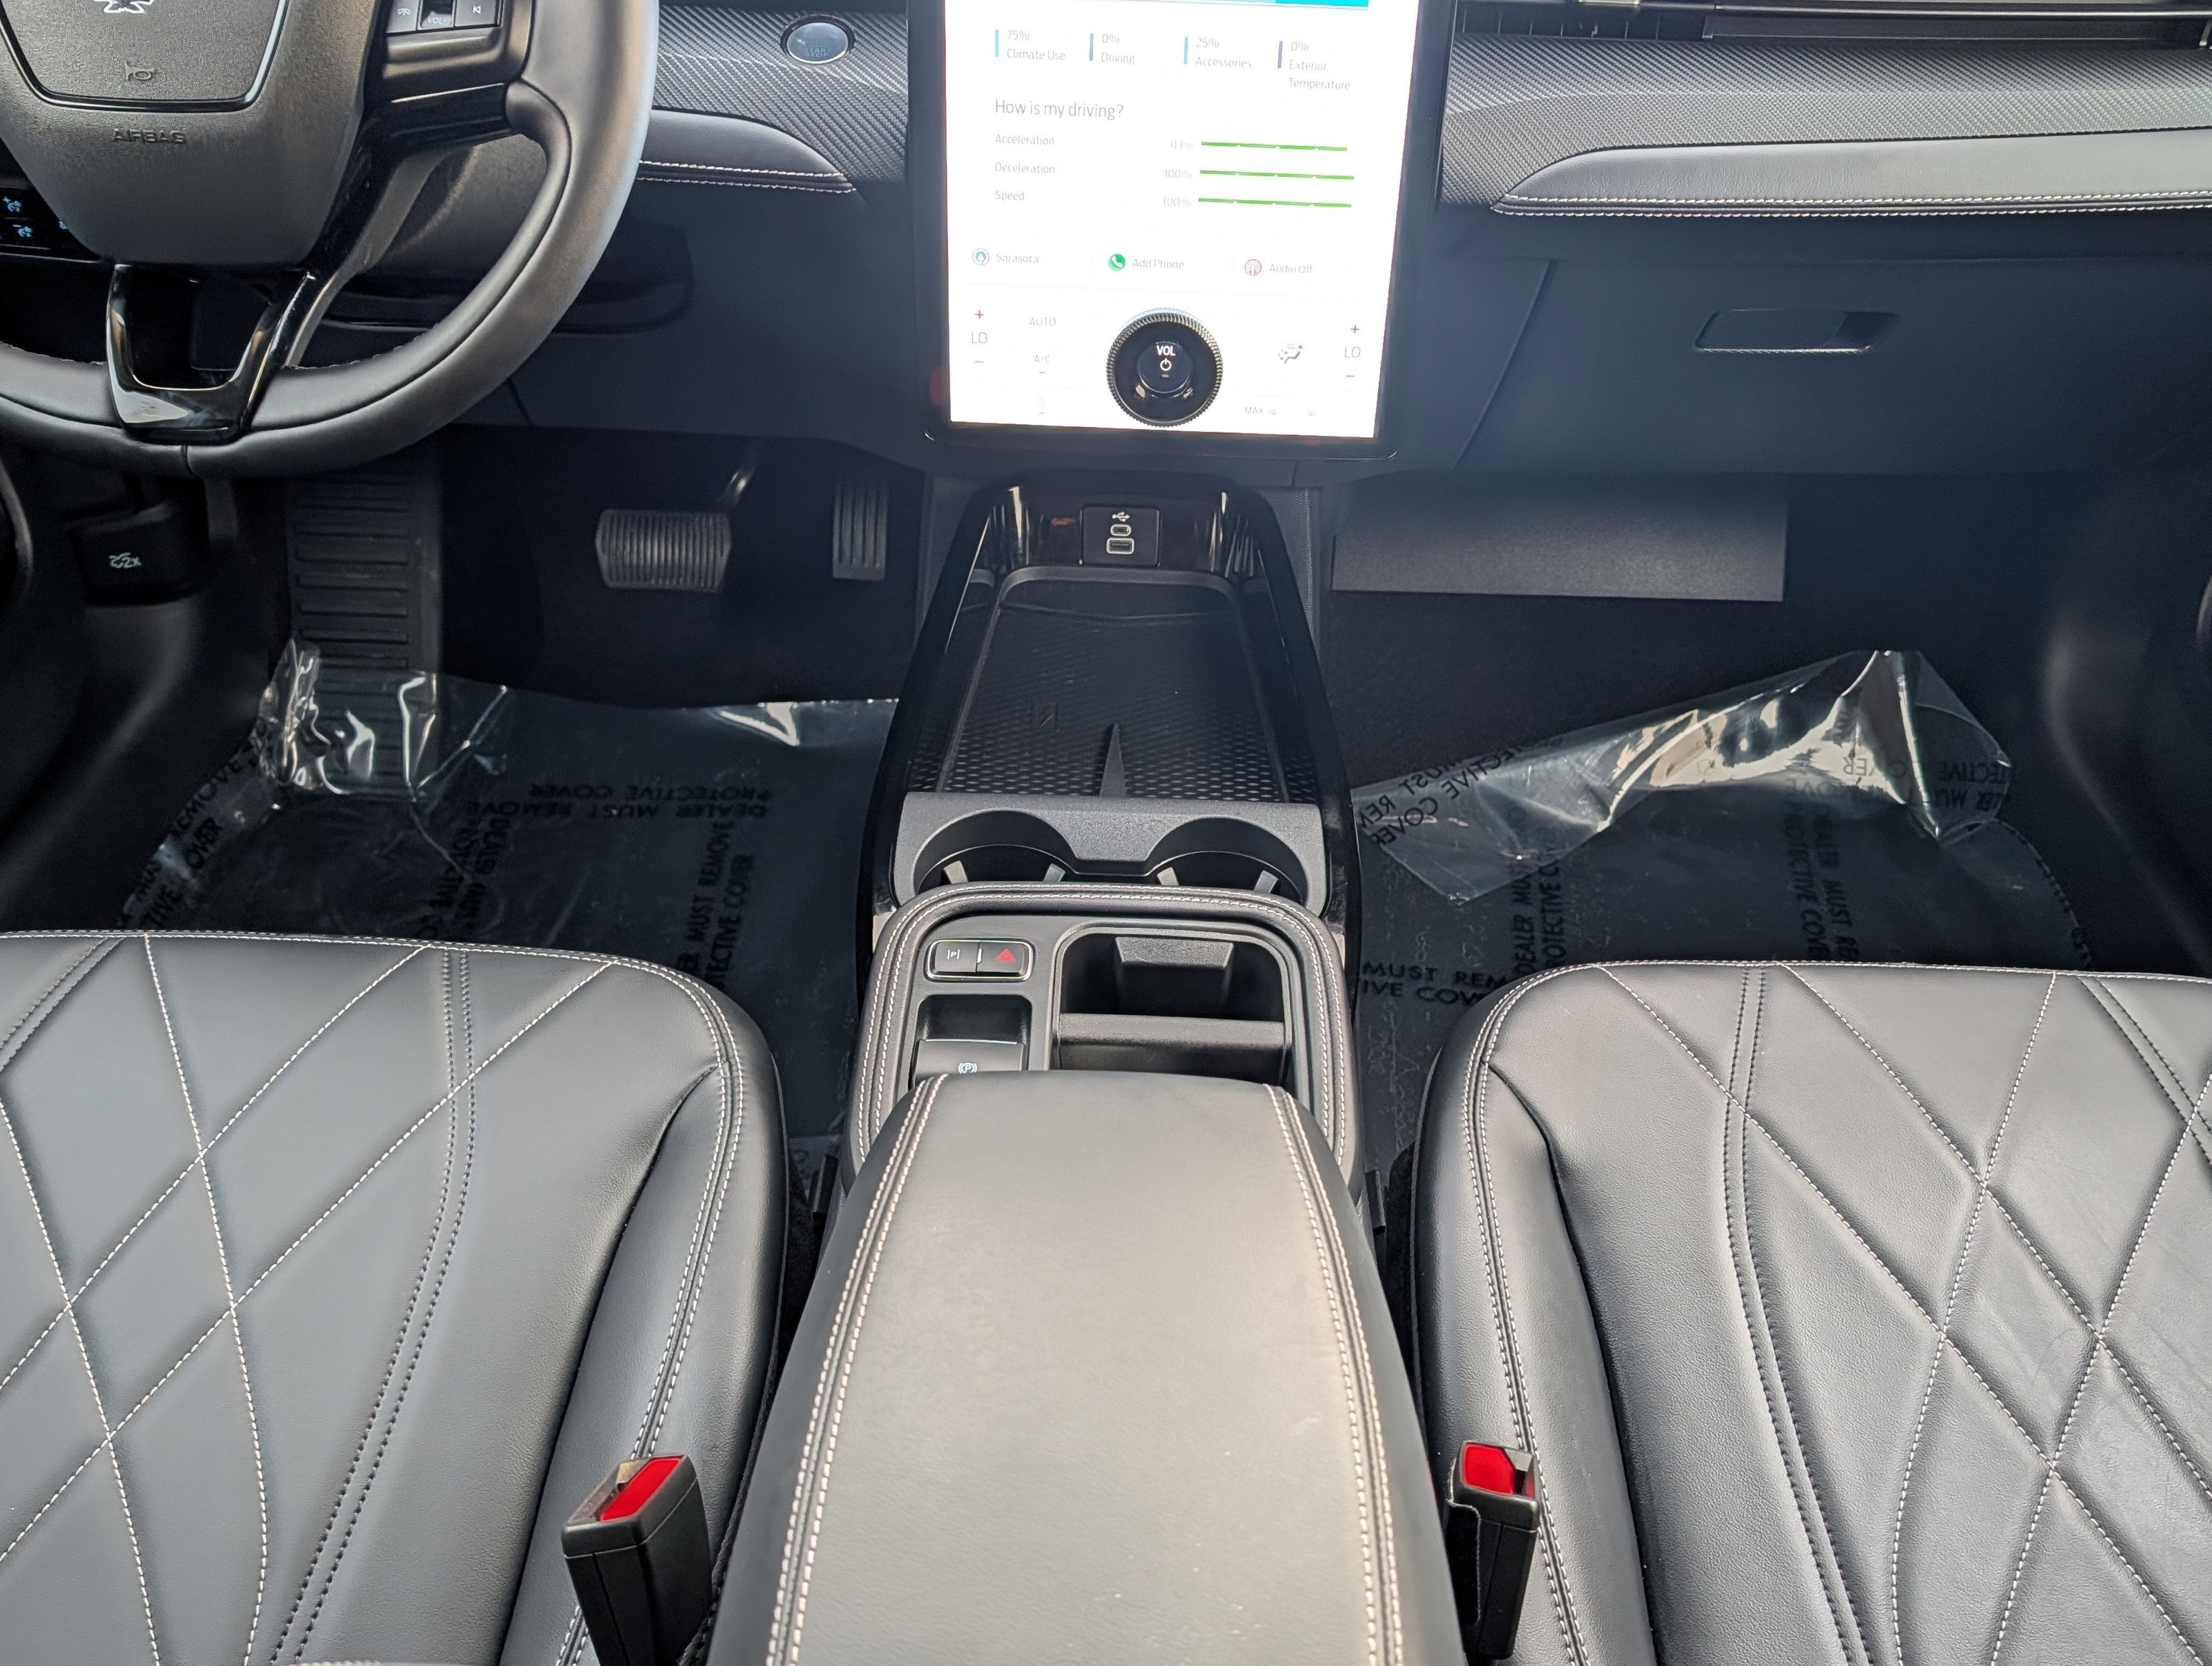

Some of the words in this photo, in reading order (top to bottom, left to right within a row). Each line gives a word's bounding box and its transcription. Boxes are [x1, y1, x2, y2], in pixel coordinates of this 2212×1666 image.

[1007, 30, 1030, 41] 75%
[1101, 34, 1120, 44] 0%
[1196, 37, 1220, 48] 25%
[1290, 41, 1310, 52] 0%
[1006, 48, 1045, 60] Climate
[1047, 50, 1066, 61] Use
[1101, 52, 1135, 65] Driving
[1195, 56, 1252, 68] Accessories
[1289, 59, 1327, 71] Exterior
[1289, 78, 1351, 90] Temperature
[995, 99, 1026, 114] How
[1030, 100, 1041, 115] is
[1044, 105, 1065, 119] my
[1068, 102, 1124, 120] driving?
[113, 129, 188, 145] AIRBAG
[995, 133, 1055, 145] Acceleration
[995, 162, 1056, 174] Deceleration
[1165, 169, 1192, 179] 100%
[995, 190, 1025, 202] Speed
[1163, 196, 1191, 207] 100%
[996, 252, 1039, 264] Sarasota
[1132, 258, 1152, 268] Add
[1156, 259, 1185, 270] Phone
[1269, 263, 1296, 273] Audio
[1298, 264, 1313, 274] Off
[1029, 317, 1057, 326] AUTO
[971, 332, 988, 344] LO
[1156, 345, 1176, 356] VOL
[1344, 346, 1361, 358] LO
[1034, 355, 1050, 364] A/C
[1244, 406, 1264, 415] MAX
[1362, 960, 1437, 982] MUST
